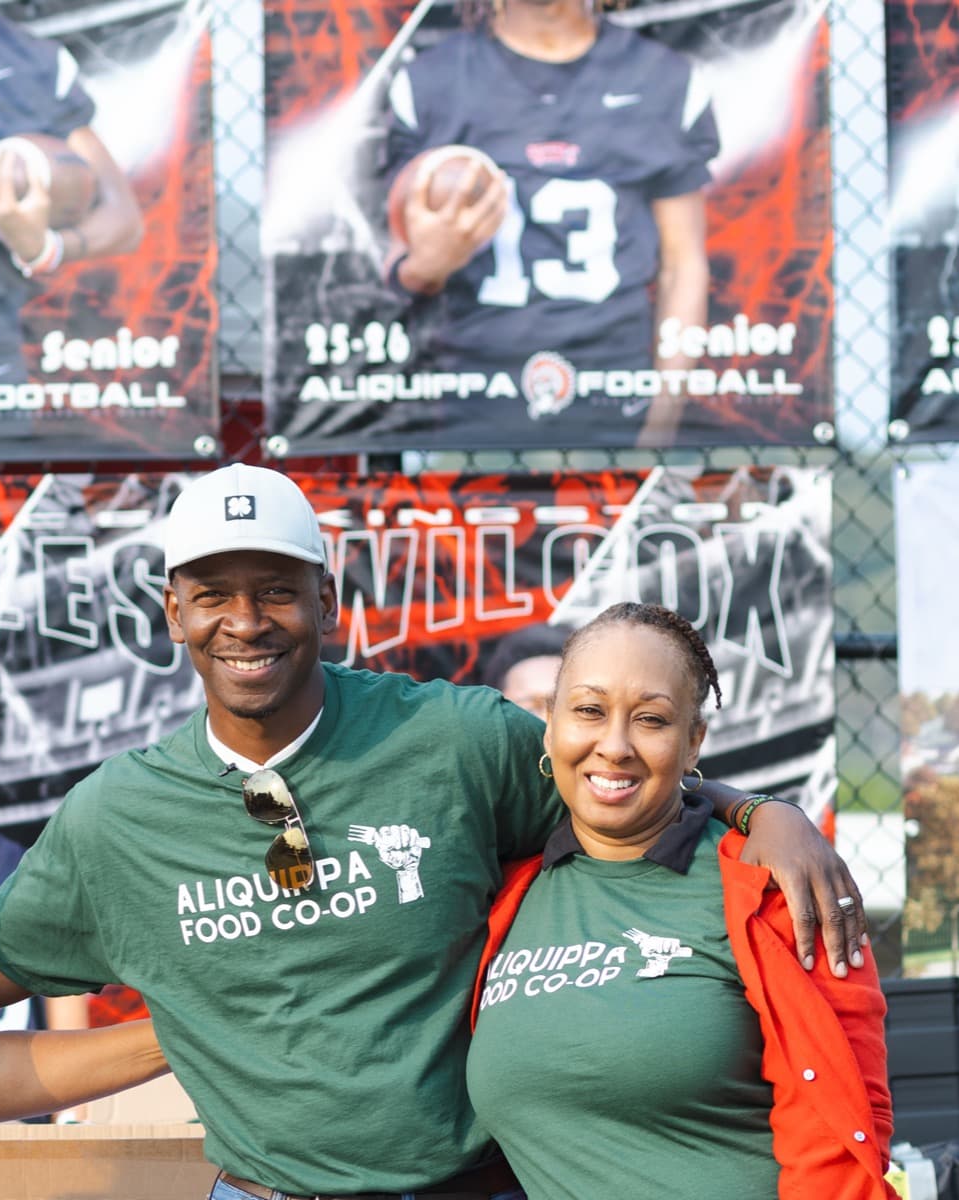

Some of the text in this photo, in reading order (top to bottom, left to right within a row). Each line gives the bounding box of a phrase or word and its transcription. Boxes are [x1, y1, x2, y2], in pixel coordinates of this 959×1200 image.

[477, 177, 621, 307] 13
[41, 327, 180, 373] Senior
[658, 313, 797, 359] Senior
[299, 367, 804, 402] ALIQUIPPA FOOTBALL
[177, 850, 373, 915] ALIQUIPPA
[180, 886, 377, 946] FOOD CO-OP
[487, 941, 628, 981] LIQUIPPA
[524, 966, 621, 997] CO-OP
